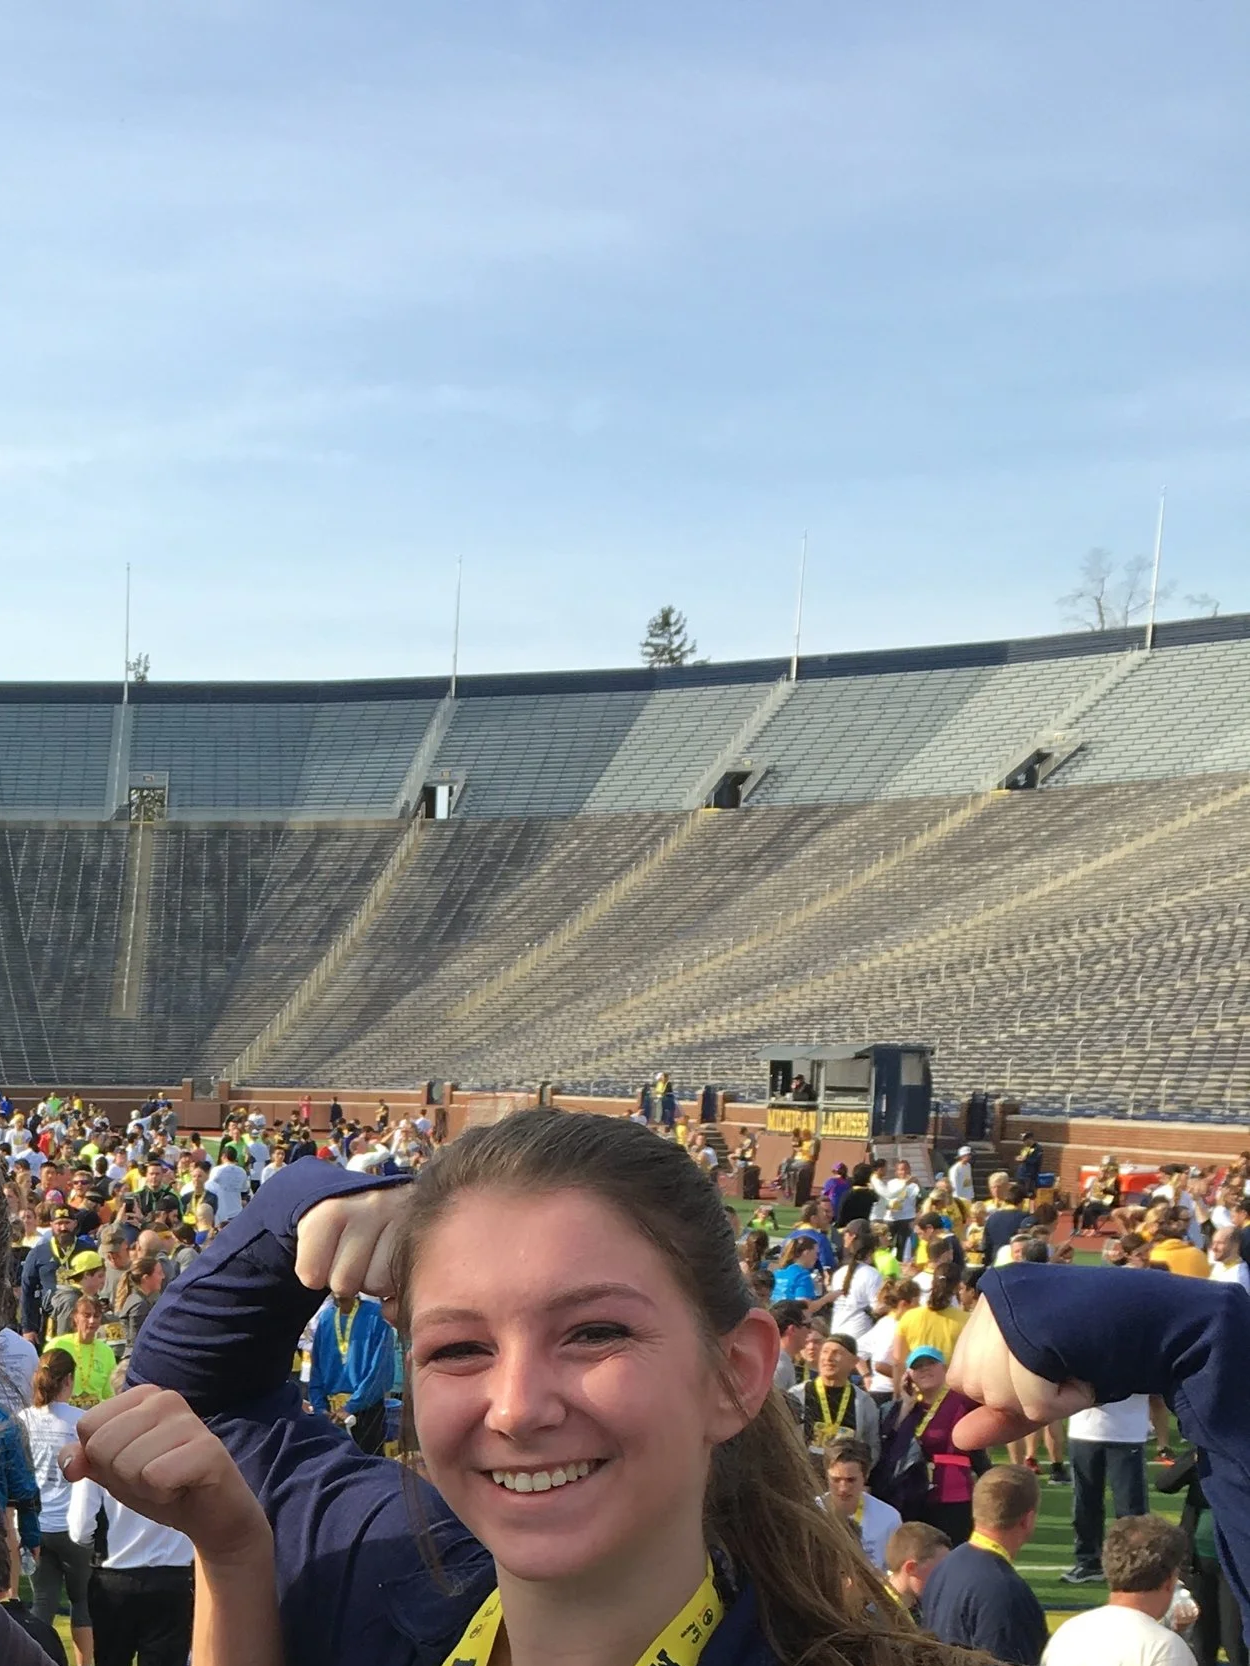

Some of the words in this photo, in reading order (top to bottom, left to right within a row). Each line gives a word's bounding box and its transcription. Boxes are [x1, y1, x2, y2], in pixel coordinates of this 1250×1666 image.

[767, 1109, 818, 1133] MICHIGAN
[820, 1111, 869, 1137] LACROSSE
[54, 1208, 70, 1217] M
